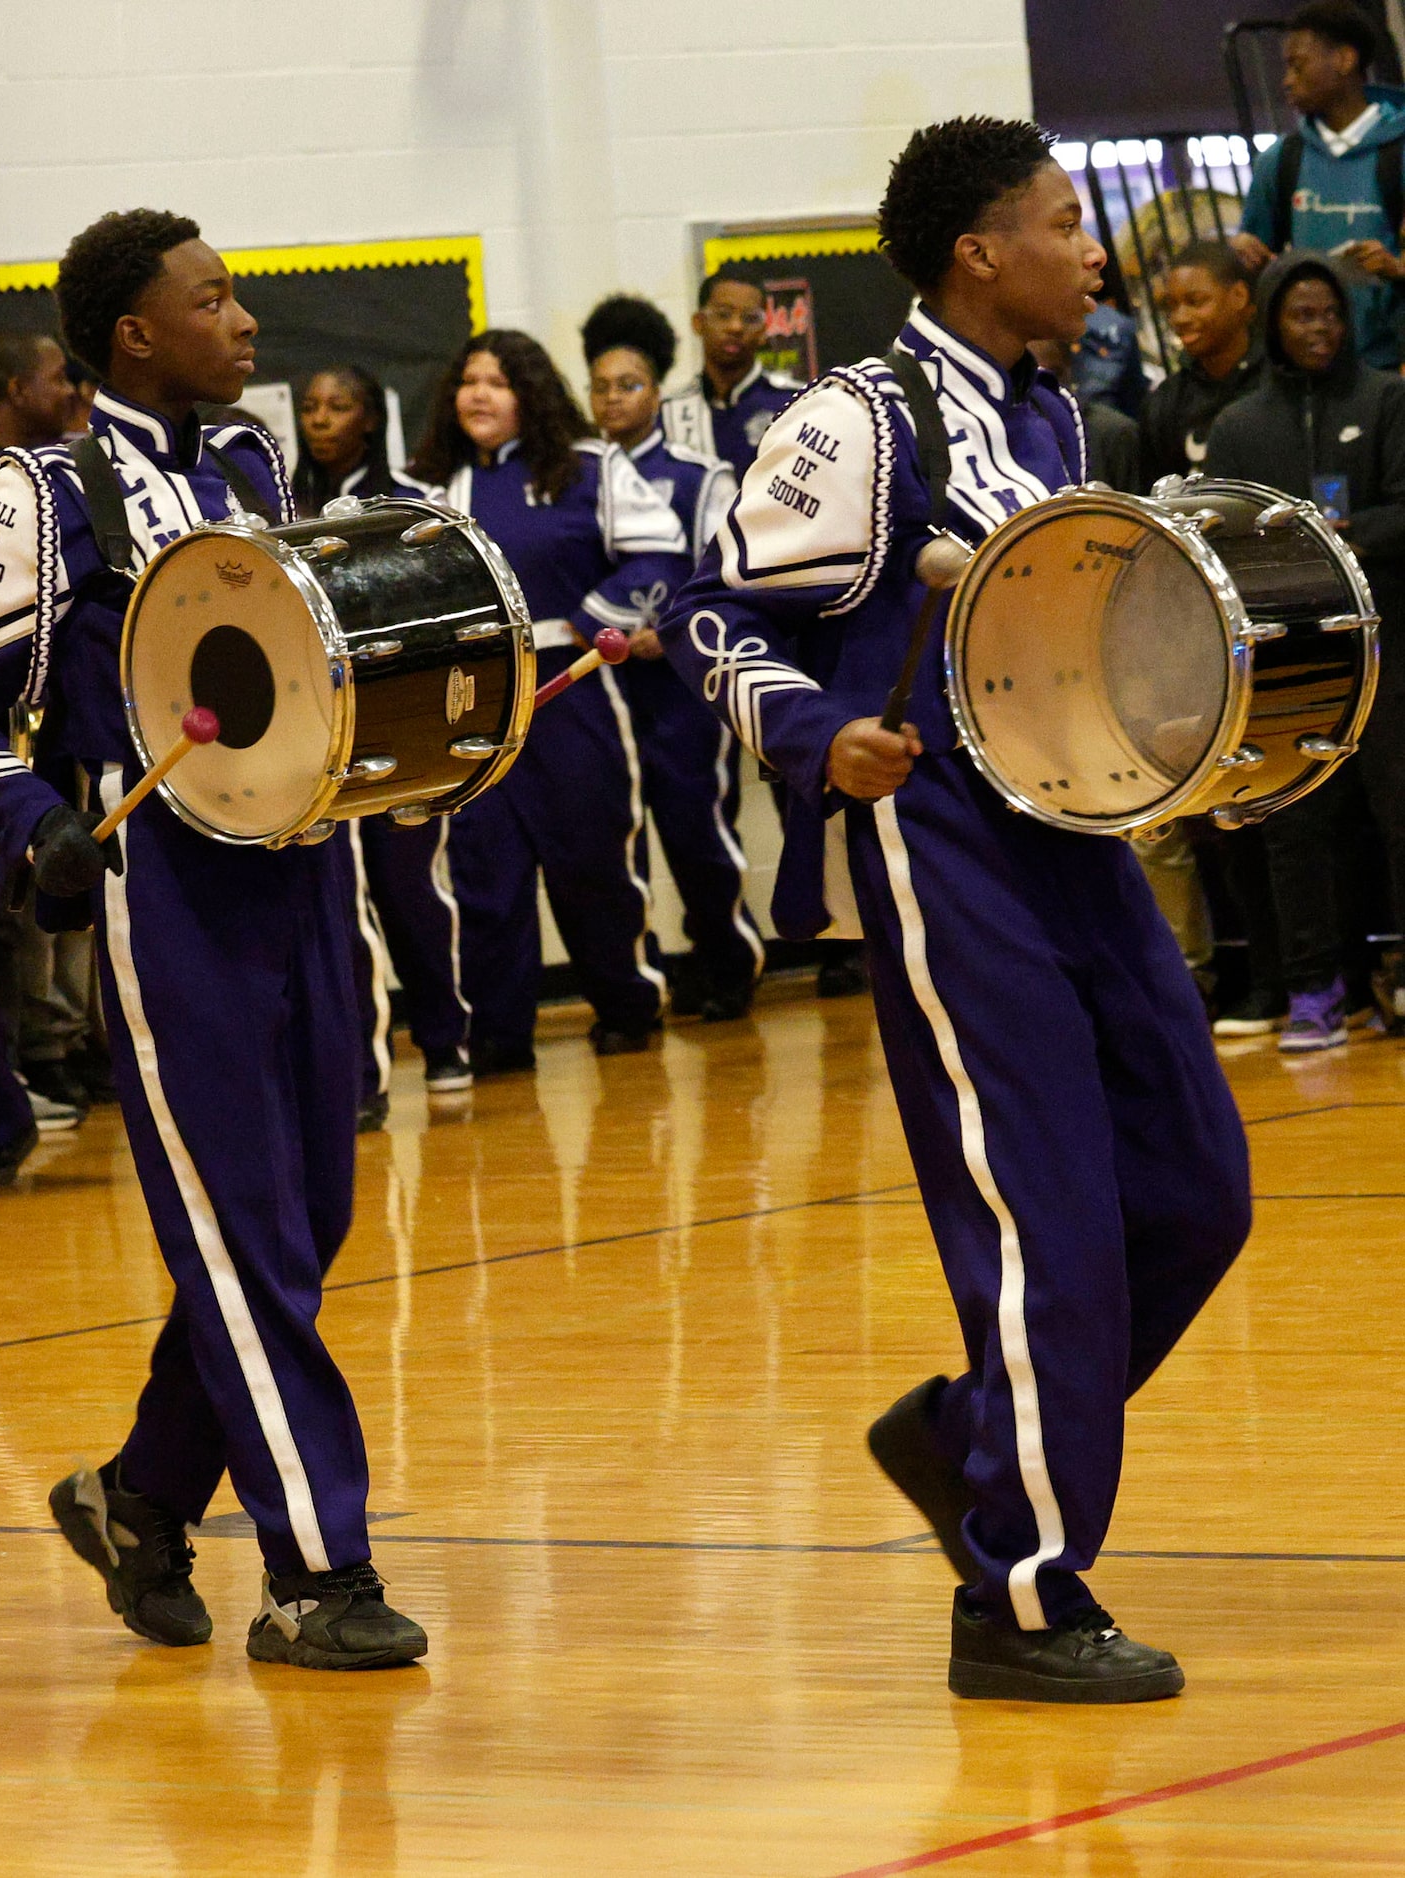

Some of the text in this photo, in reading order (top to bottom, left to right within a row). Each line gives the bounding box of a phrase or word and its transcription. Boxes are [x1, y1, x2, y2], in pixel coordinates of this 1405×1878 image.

[1291, 188, 1382, 225] Champion
[796, 422, 840, 463] WALL
[792, 456, 818, 481] OF
[767, 474, 820, 519] SOUND
